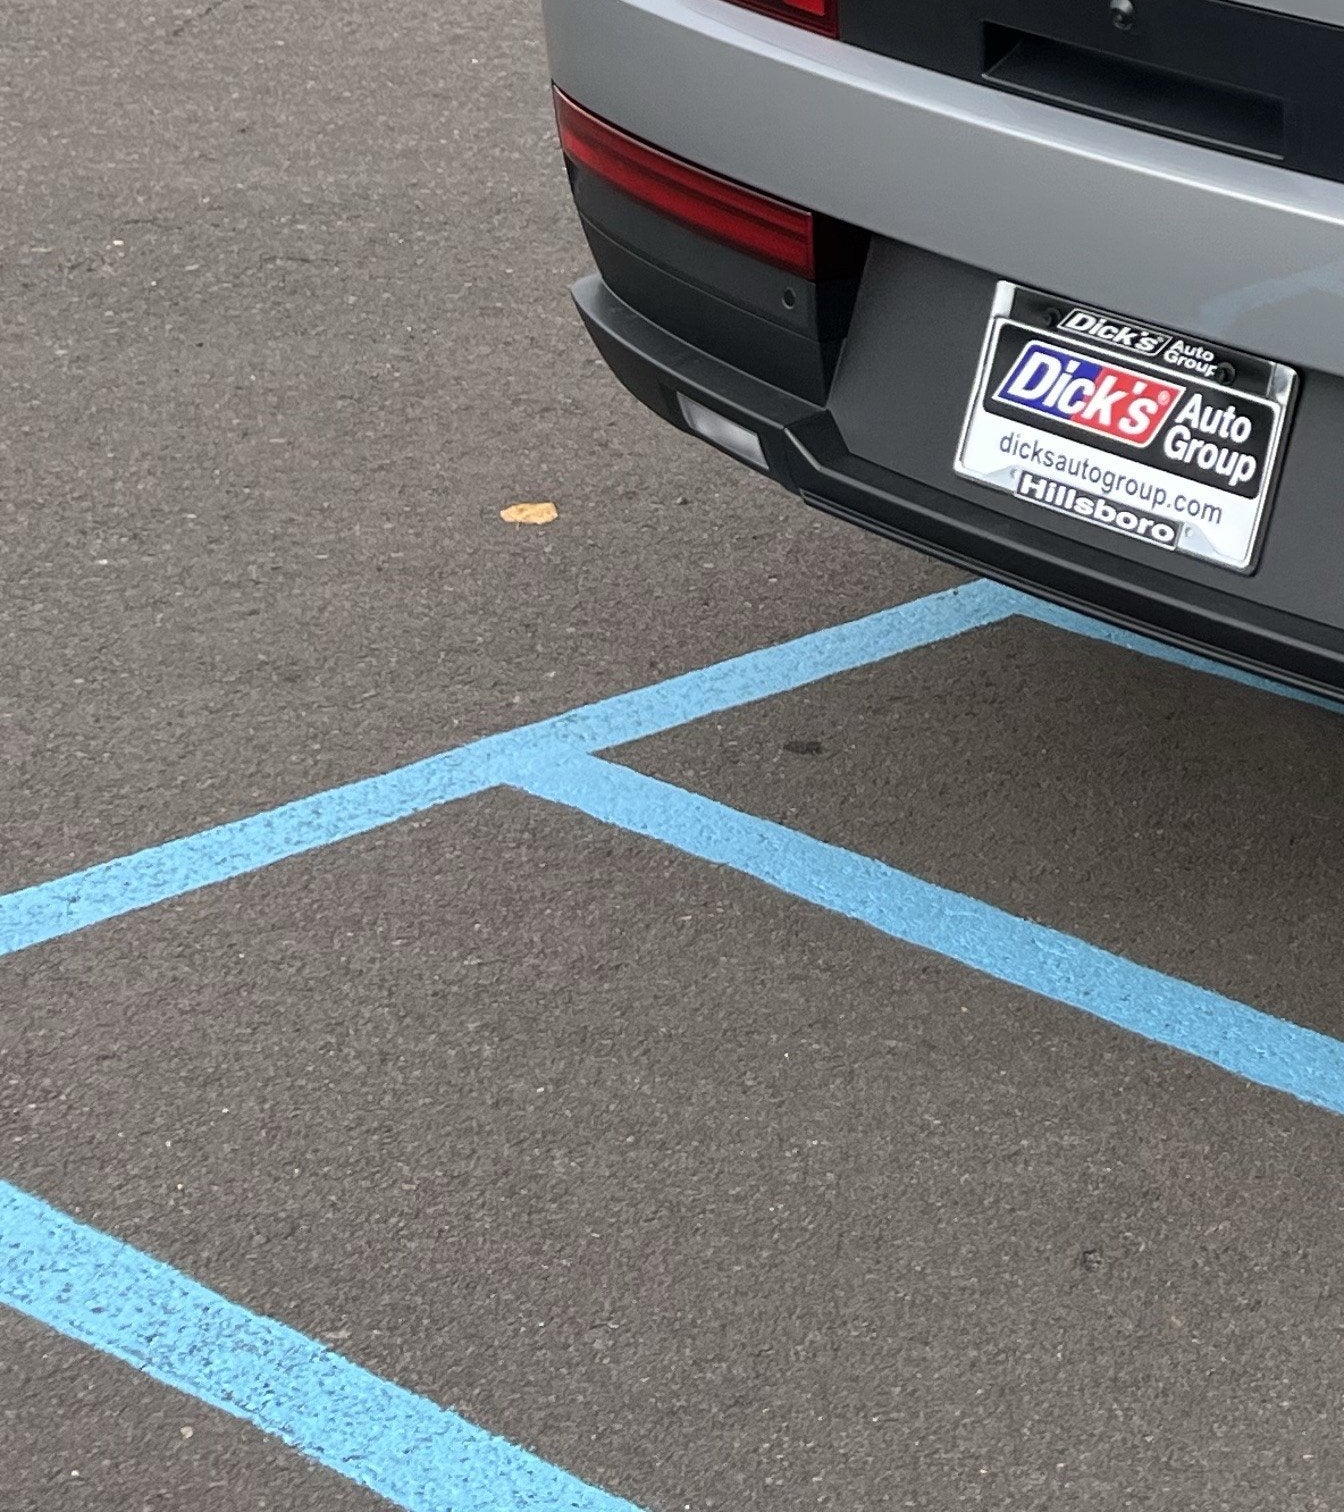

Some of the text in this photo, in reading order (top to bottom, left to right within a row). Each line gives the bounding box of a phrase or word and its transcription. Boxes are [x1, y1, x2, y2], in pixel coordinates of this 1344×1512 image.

[1066, 311, 1158, 352] Dick's
[1169, 340, 1214, 363] Auto
[1006, 351, 1159, 436] Dick's
[1175, 393, 1251, 444] Auto
[999, 432, 1224, 525] dicksautogroup.com
[1163, 424, 1257, 487] Group
[1018, 473, 1176, 541] Hillsboro
